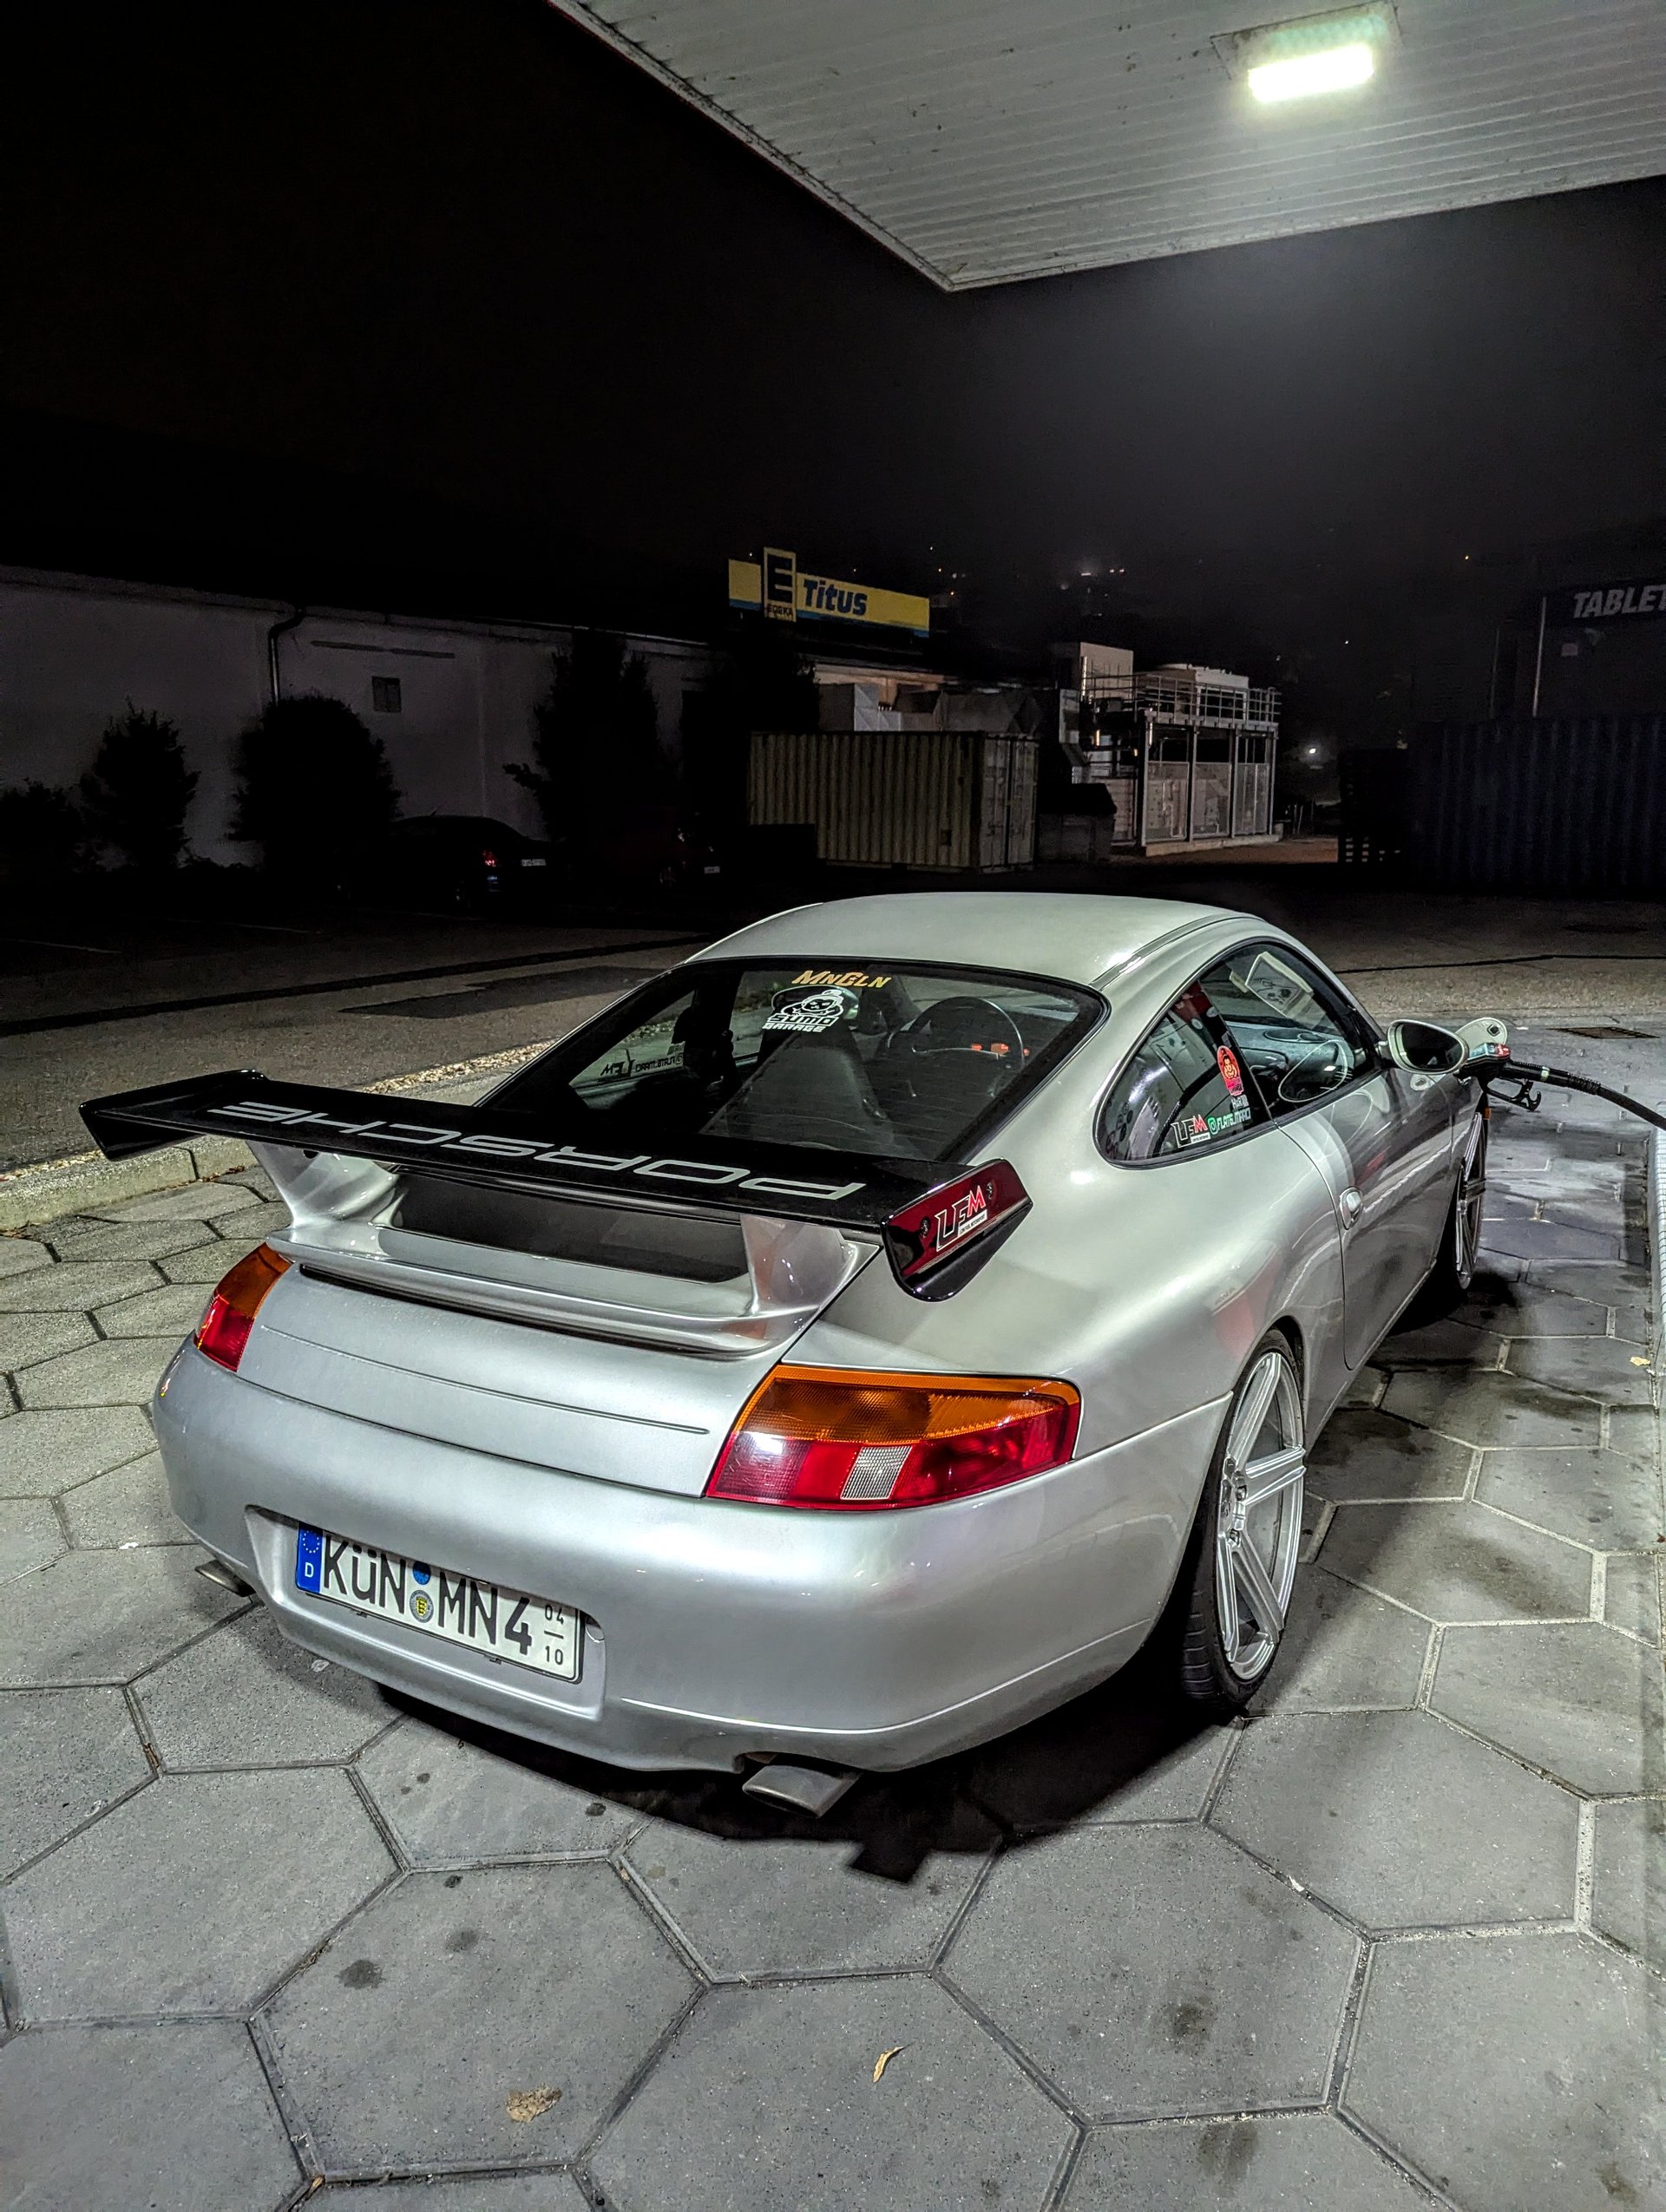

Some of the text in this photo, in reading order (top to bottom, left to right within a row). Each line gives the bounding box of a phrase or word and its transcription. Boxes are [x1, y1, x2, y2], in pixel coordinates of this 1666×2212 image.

[767, 554, 793, 604] E
[803, 579, 868, 616] Titus
[762, 1022, 826, 1032] GARAGE
[207, 1101, 867, 1201] PORSCHE
[934, 1184, 987, 1253] LFM
[304, 1561, 314, 1578] D
[544, 1604, 565, 1626] 04
[545, 1646, 564, 1666] 10
